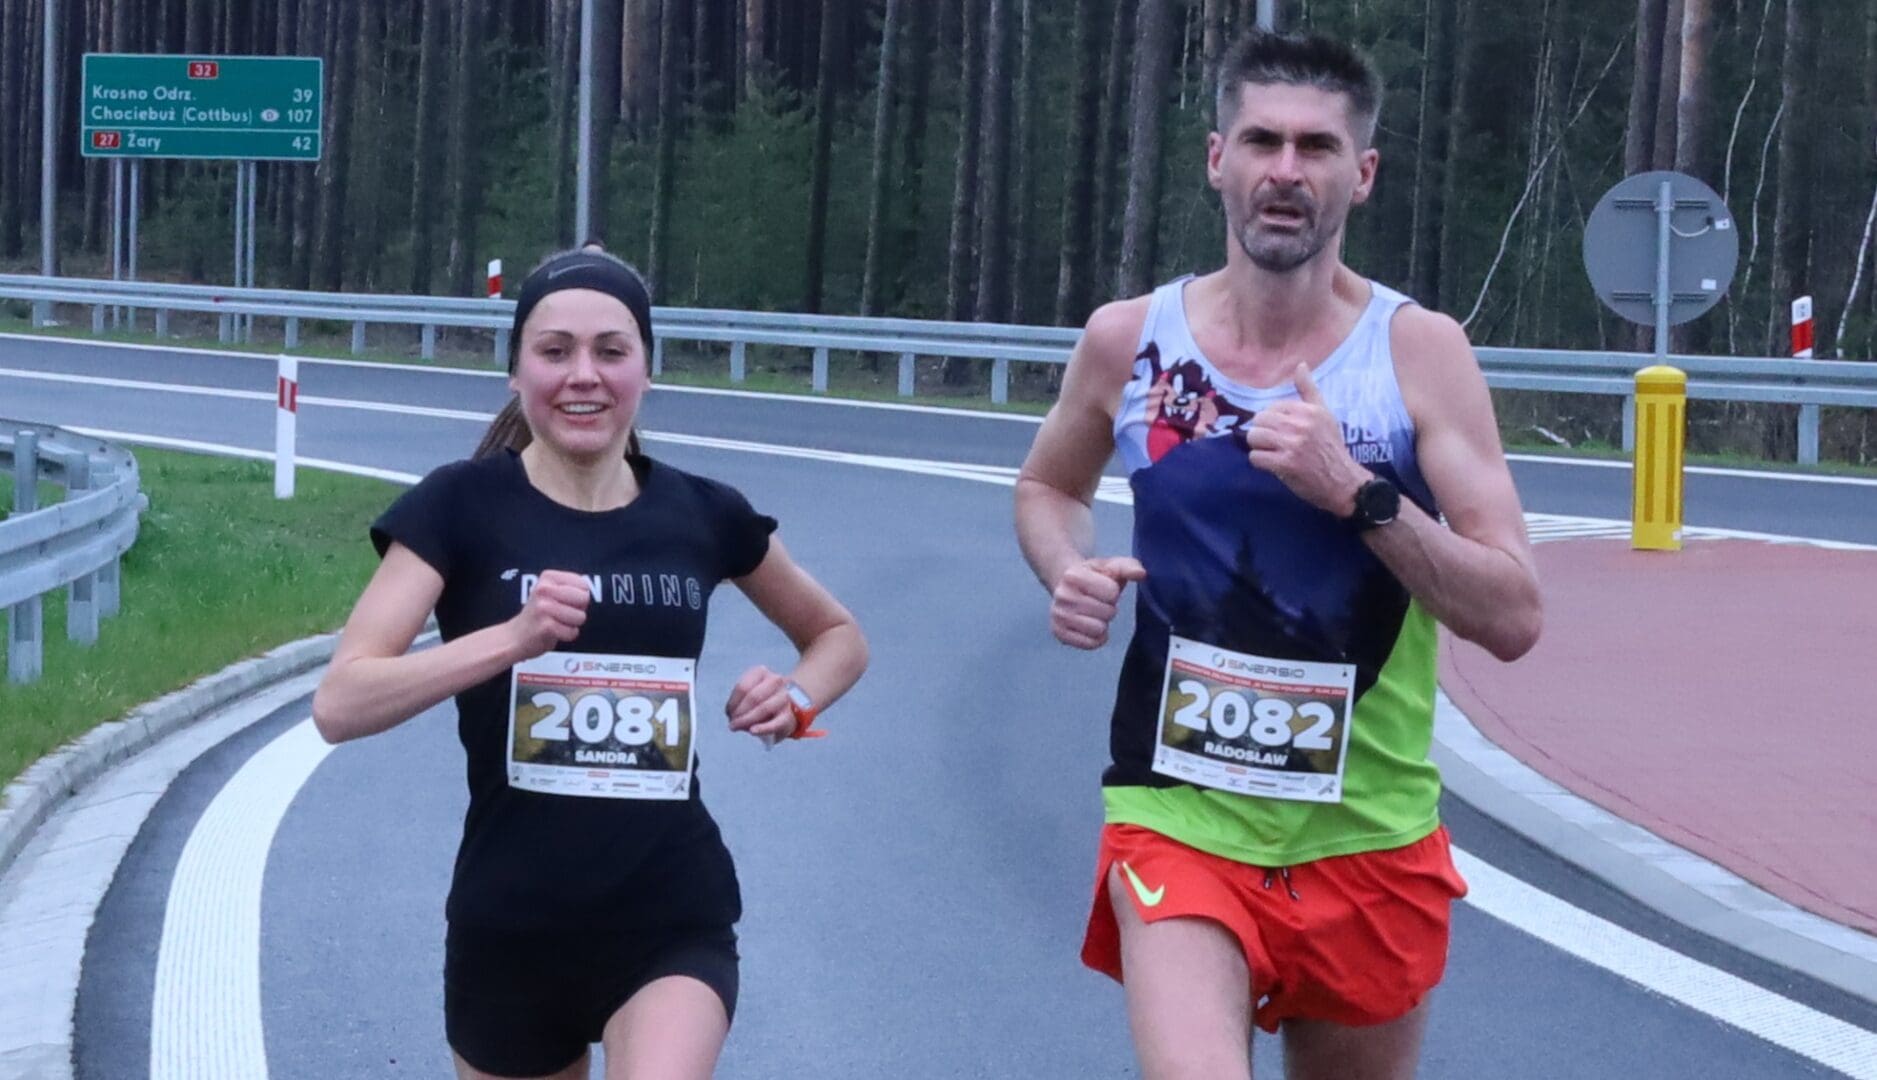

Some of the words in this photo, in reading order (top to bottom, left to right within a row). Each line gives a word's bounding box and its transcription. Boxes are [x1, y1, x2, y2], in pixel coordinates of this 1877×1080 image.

[194, 63, 212, 77] 32
[92, 85, 148, 100] Krosno
[153, 86, 197, 101] Odrz.
[292, 88, 313, 103] 39
[91, 105, 176, 121] Chociebuż
[182, 106, 253, 124] (Cottbus)
[287, 109, 313, 123] 107
[99, 133, 114, 146] 27
[291, 136, 312, 150] 42
[530, 691, 680, 747] 2081
[1173, 679, 1336, 750] 2082
[574, 750, 638, 765] SANDRA
